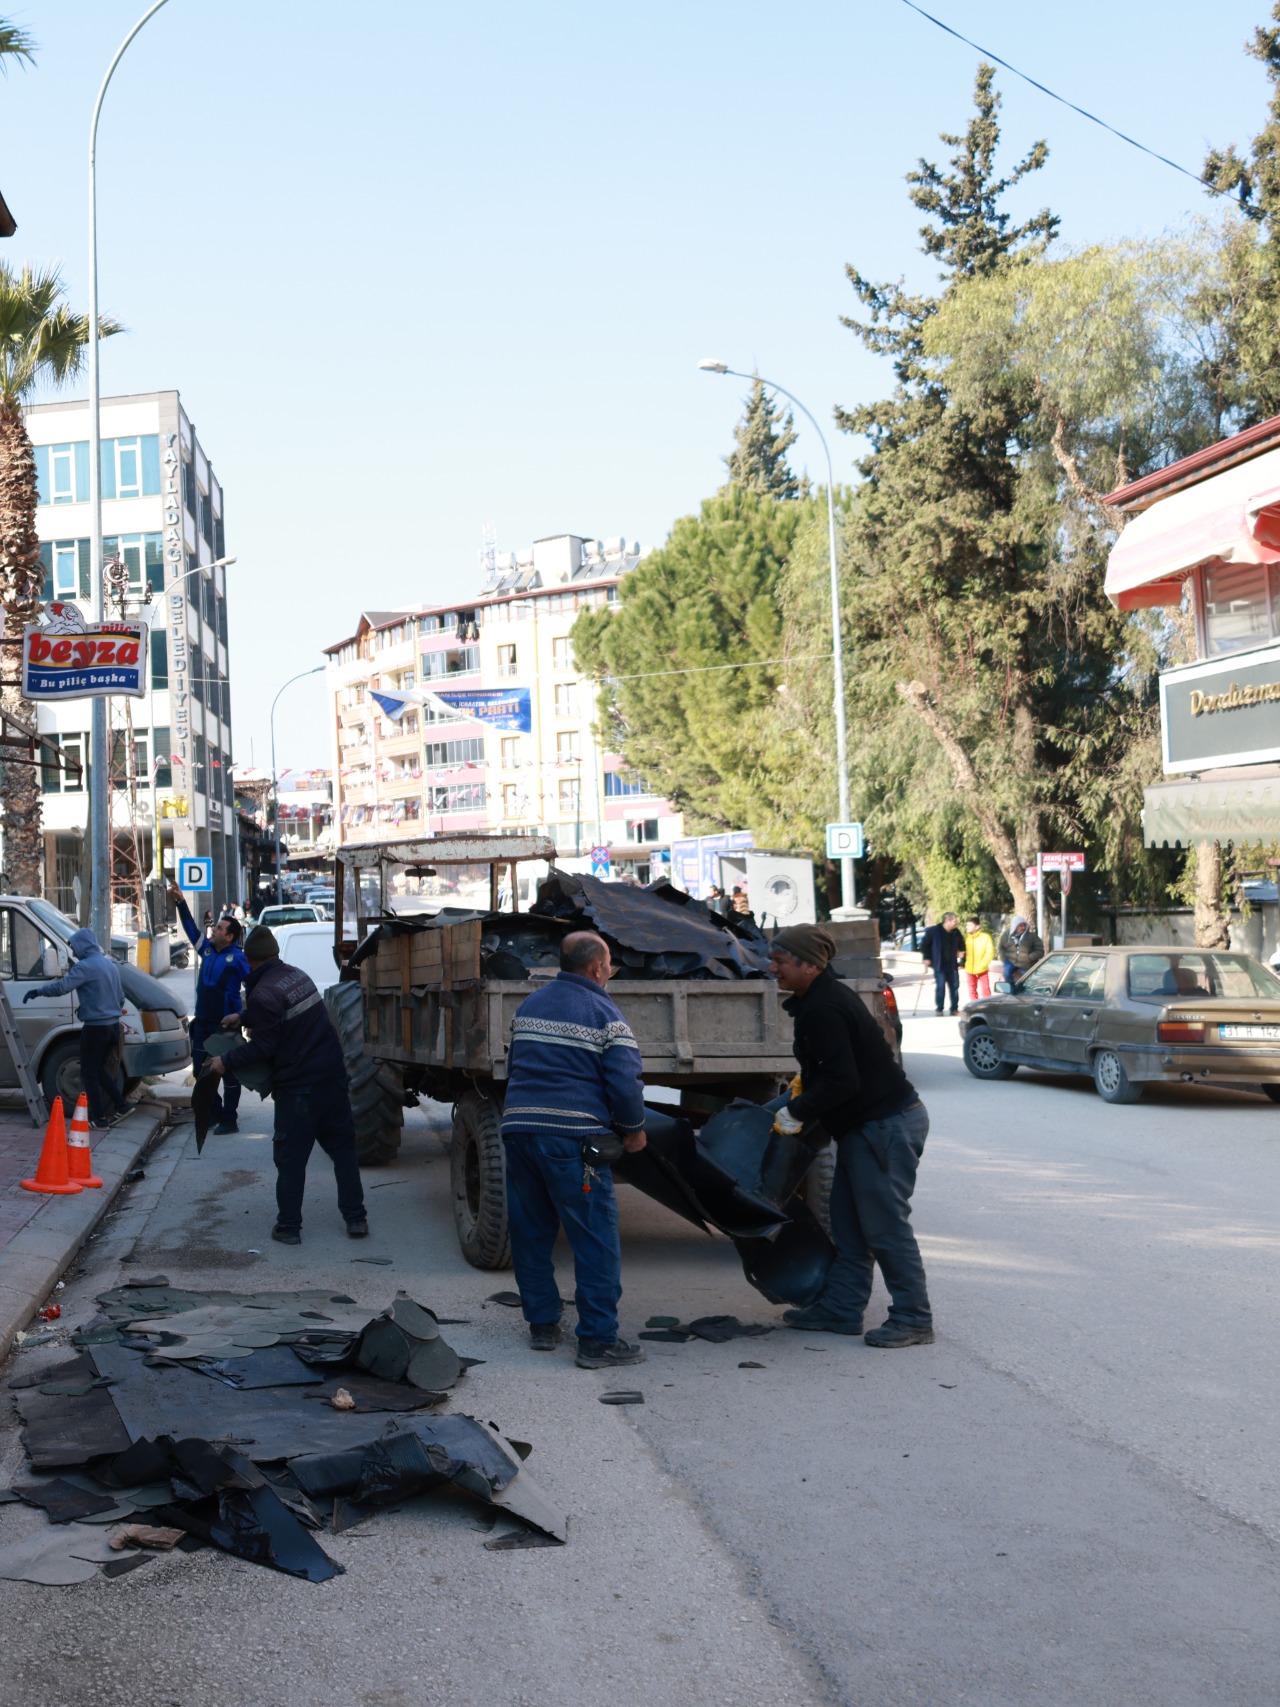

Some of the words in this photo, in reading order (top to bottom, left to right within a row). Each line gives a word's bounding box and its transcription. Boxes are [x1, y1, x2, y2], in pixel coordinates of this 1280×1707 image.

[29, 633, 139, 668] beyza
[58, 676, 87, 689] piliç
[169, 594, 188, 758] BELEDİYESİ
[838, 832, 851, 849] D
[188, 865, 203, 883] D
